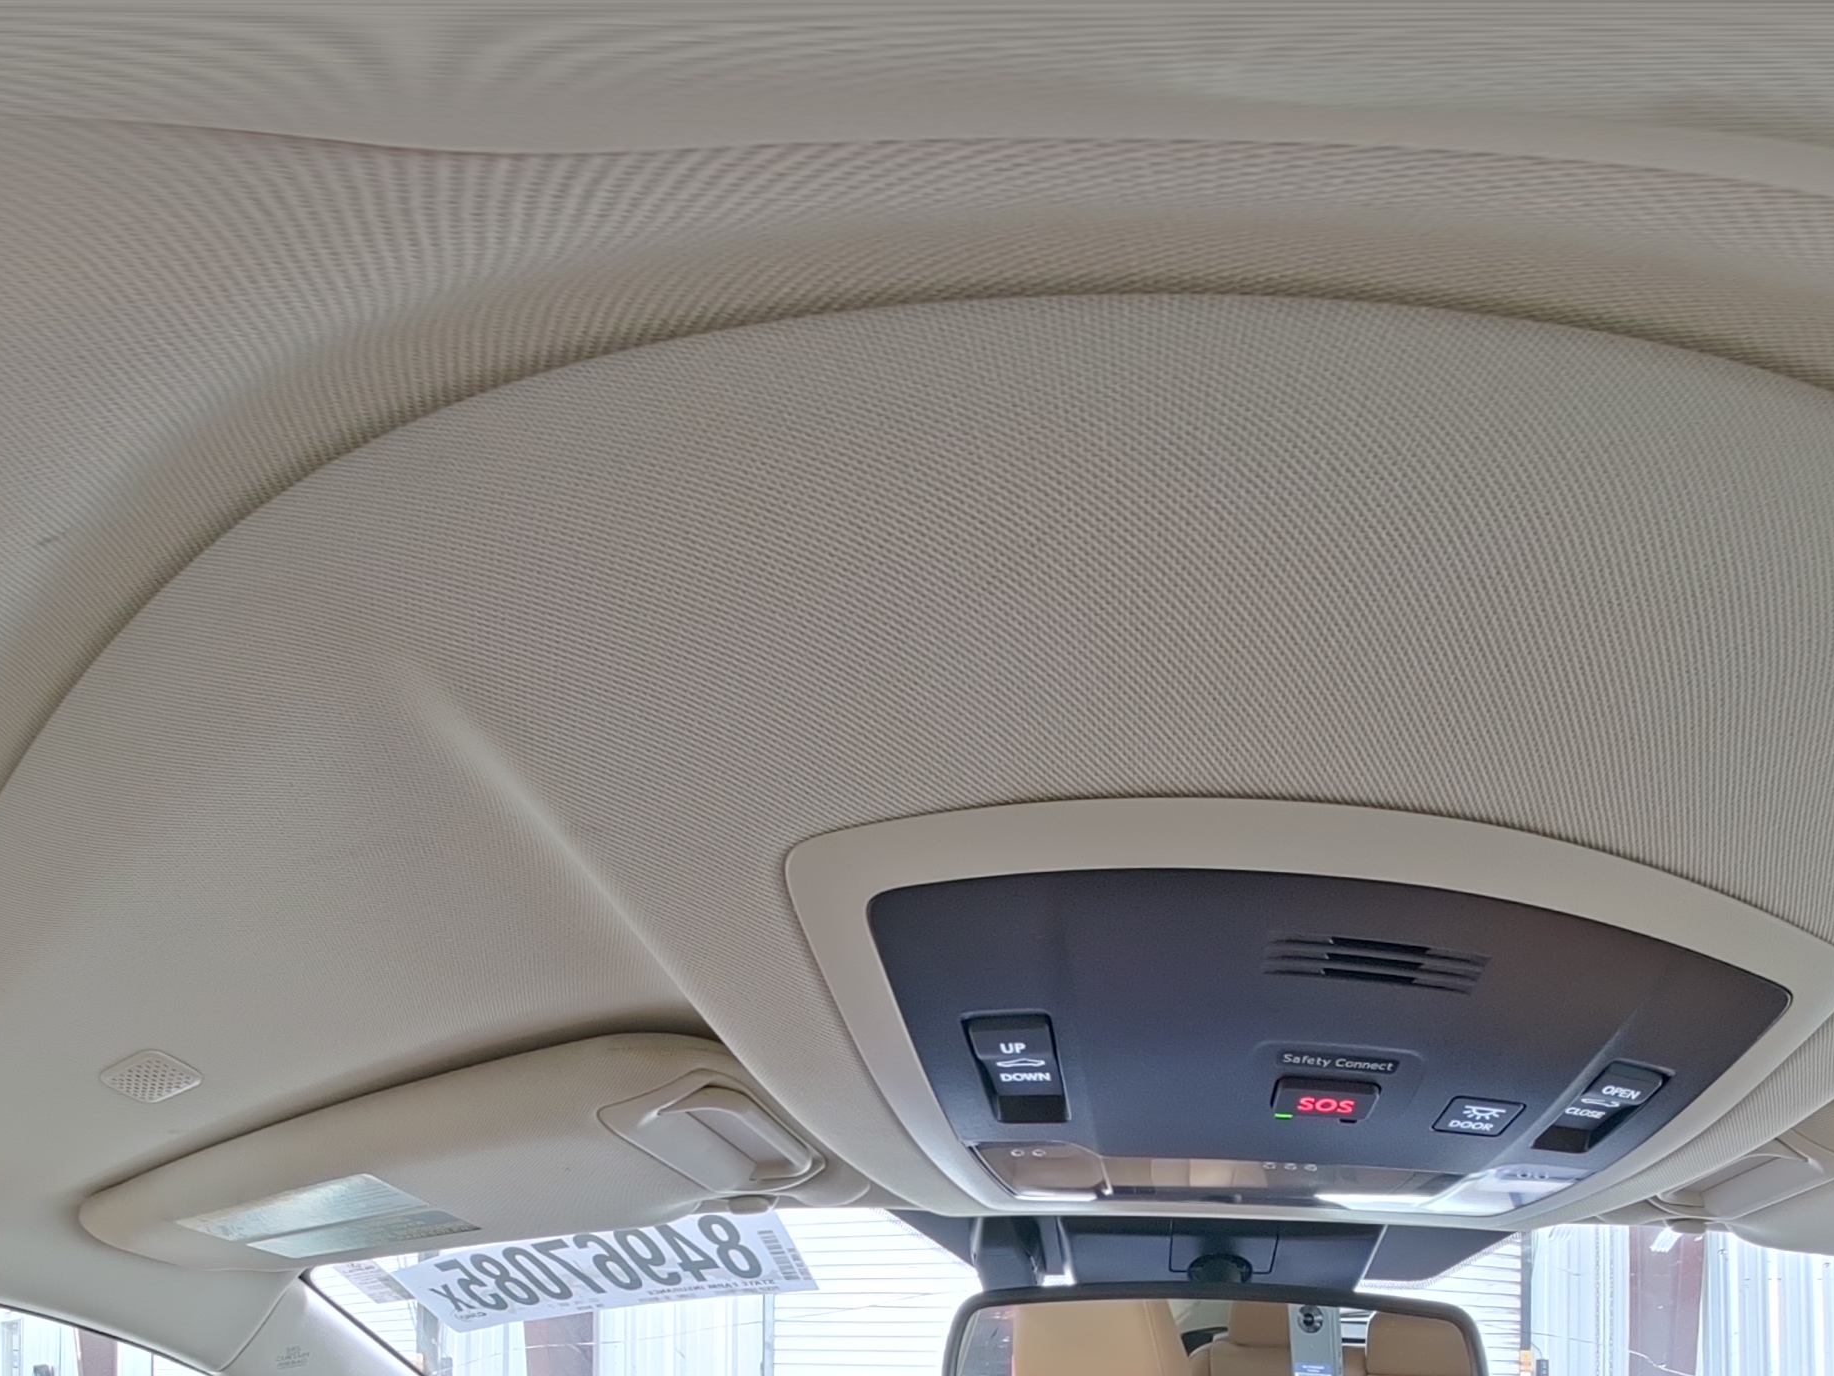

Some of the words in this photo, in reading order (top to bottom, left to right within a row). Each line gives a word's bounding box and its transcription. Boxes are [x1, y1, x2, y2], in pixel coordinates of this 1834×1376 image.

[999, 1042, 1027, 1054] UP
[1282, 1053, 1331, 1068] Safety
[1335, 1058, 1394, 1072] Connect
[999, 1072, 1052, 1083] DOWN
[1601, 1085, 1641, 1101] OPEN
[1297, 1096, 1355, 1114] SOS
[1564, 1106, 1606, 1120] CLOSE
[1448, 1119, 1494, 1132] DOOR
